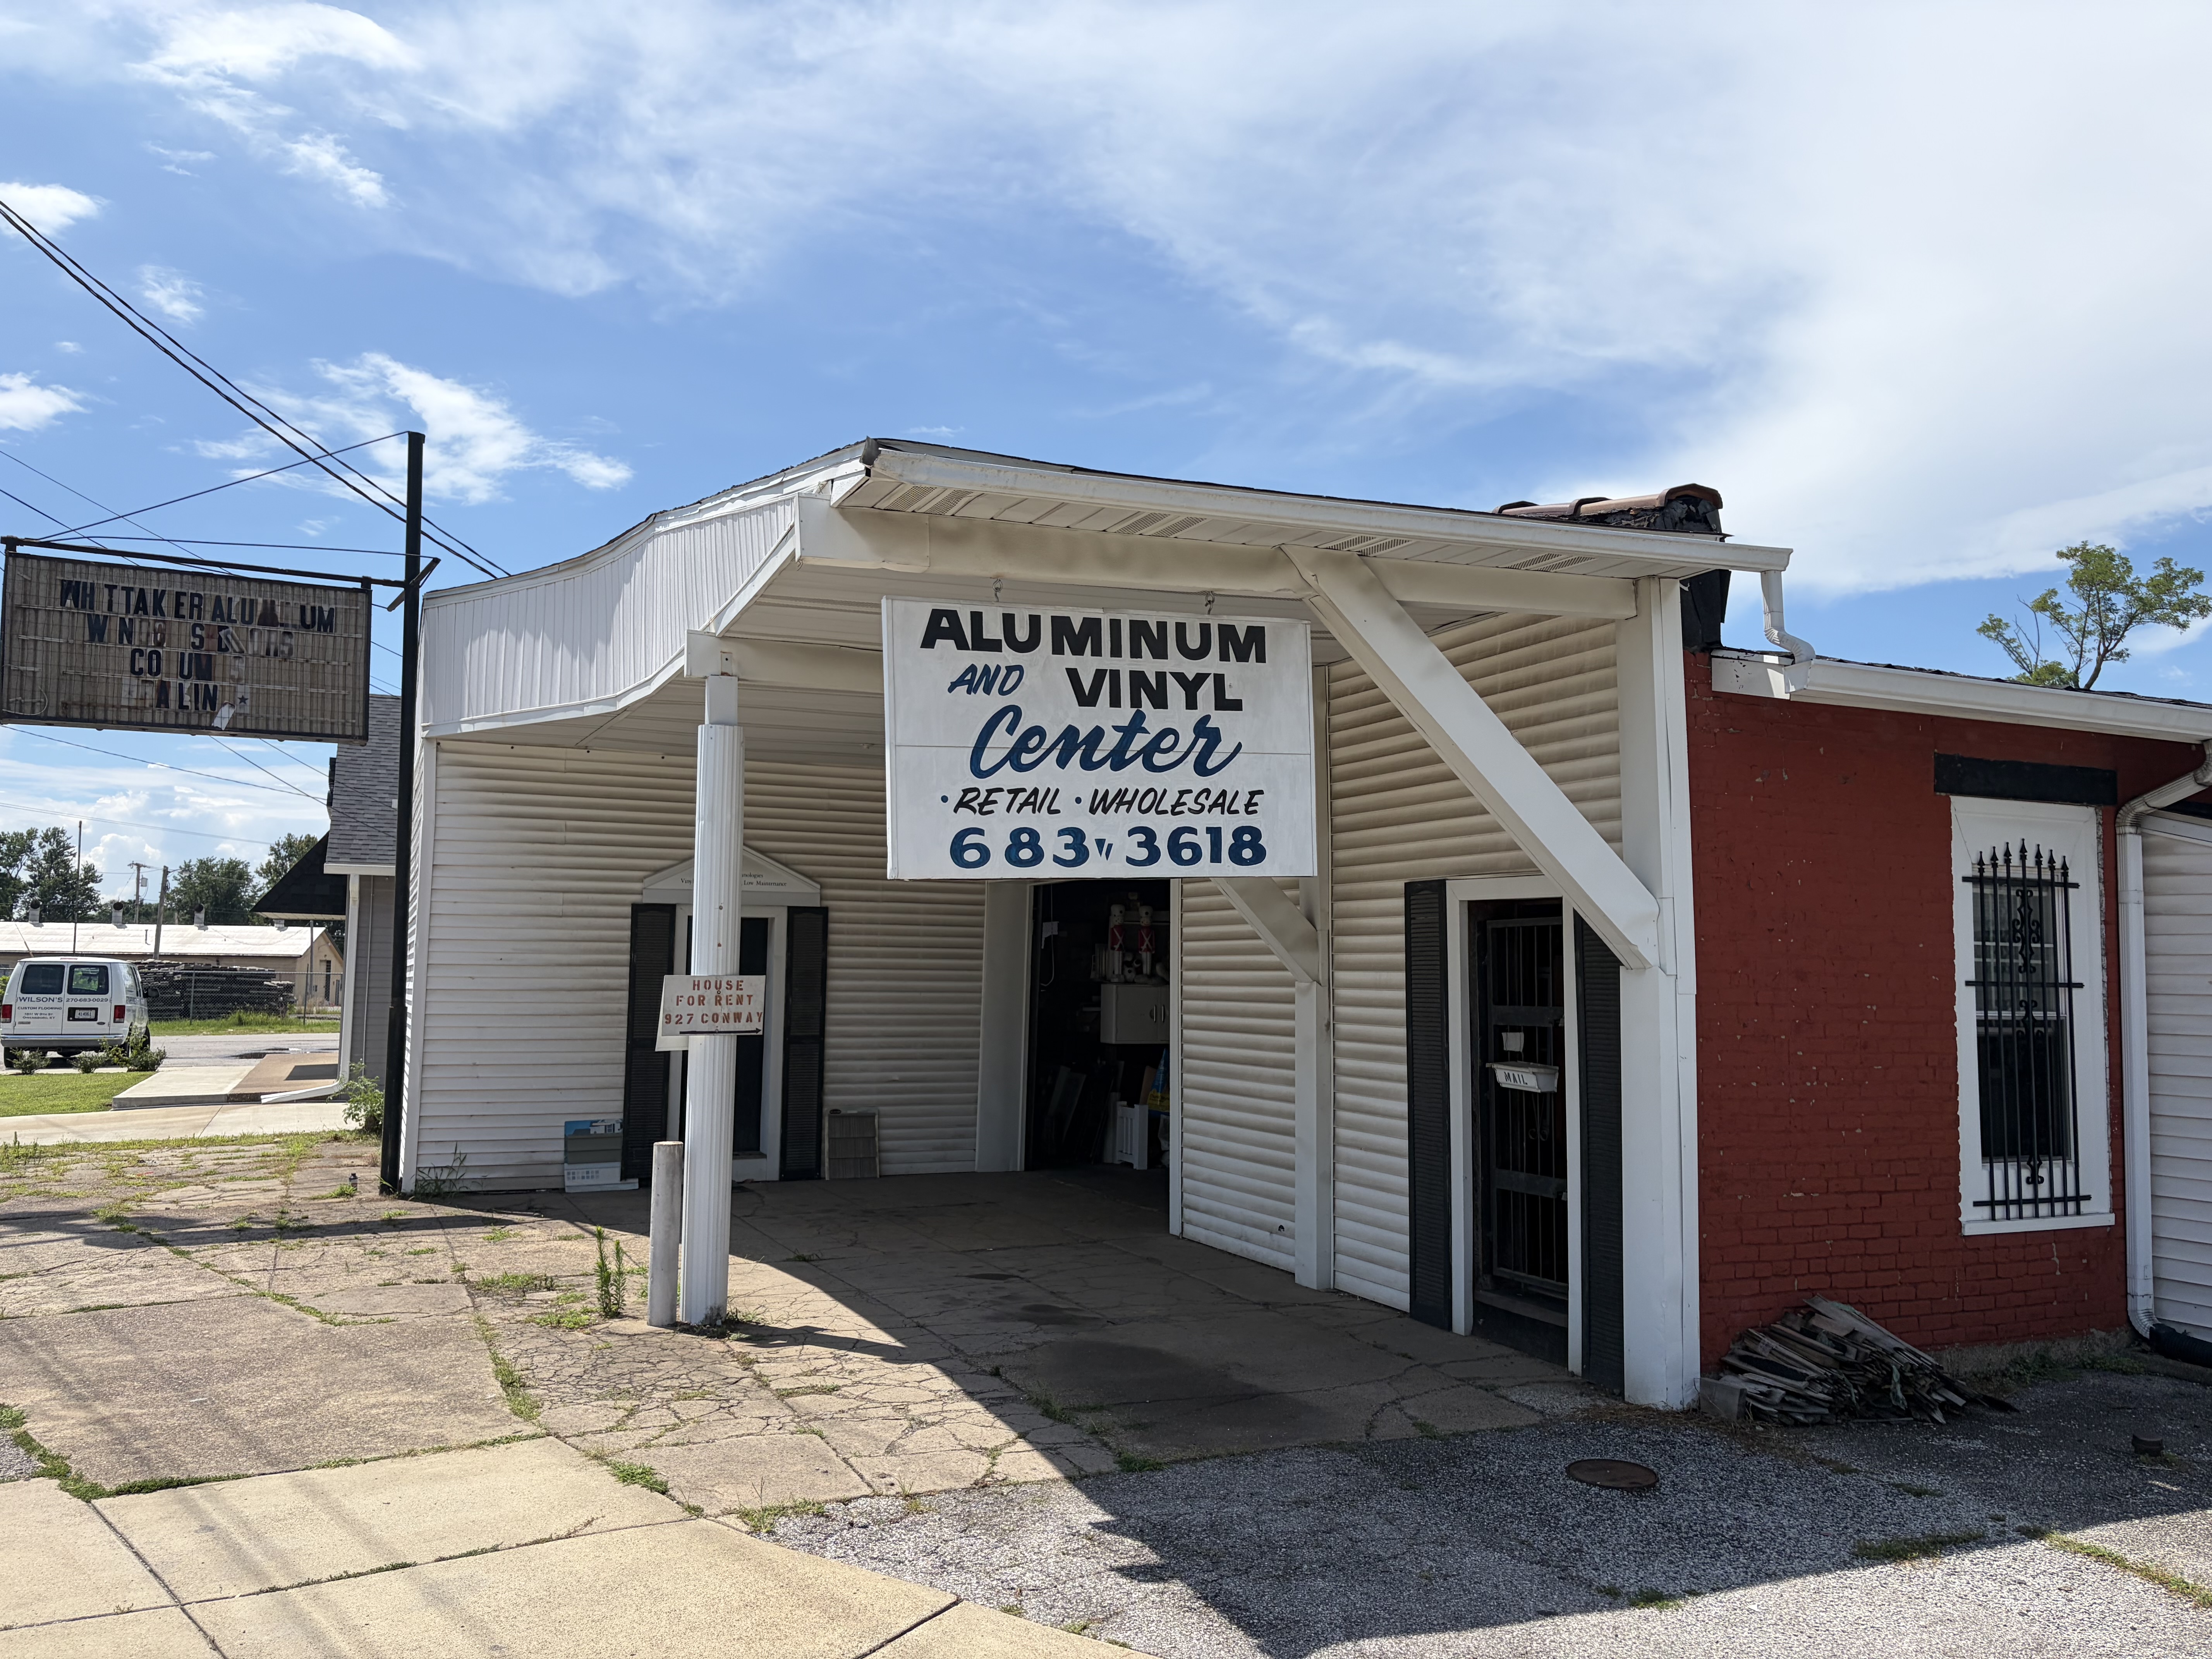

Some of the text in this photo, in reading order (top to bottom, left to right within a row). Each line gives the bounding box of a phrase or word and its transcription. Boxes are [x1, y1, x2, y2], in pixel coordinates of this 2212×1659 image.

[920, 608, 1266, 663] ALUMINUM
[948, 664, 1243, 711] AND VINYL
[970, 704, 1242, 779] Center
[953, 787, 1264, 816] RETAIL WHOLESALE
[692, 980, 744, 991] HOUSE
[676, 994, 753, 1006] FOR RENT
[665, 1012, 763, 1024] 927 CONWAY
[1504, 1072, 1528, 1085] MAIL
